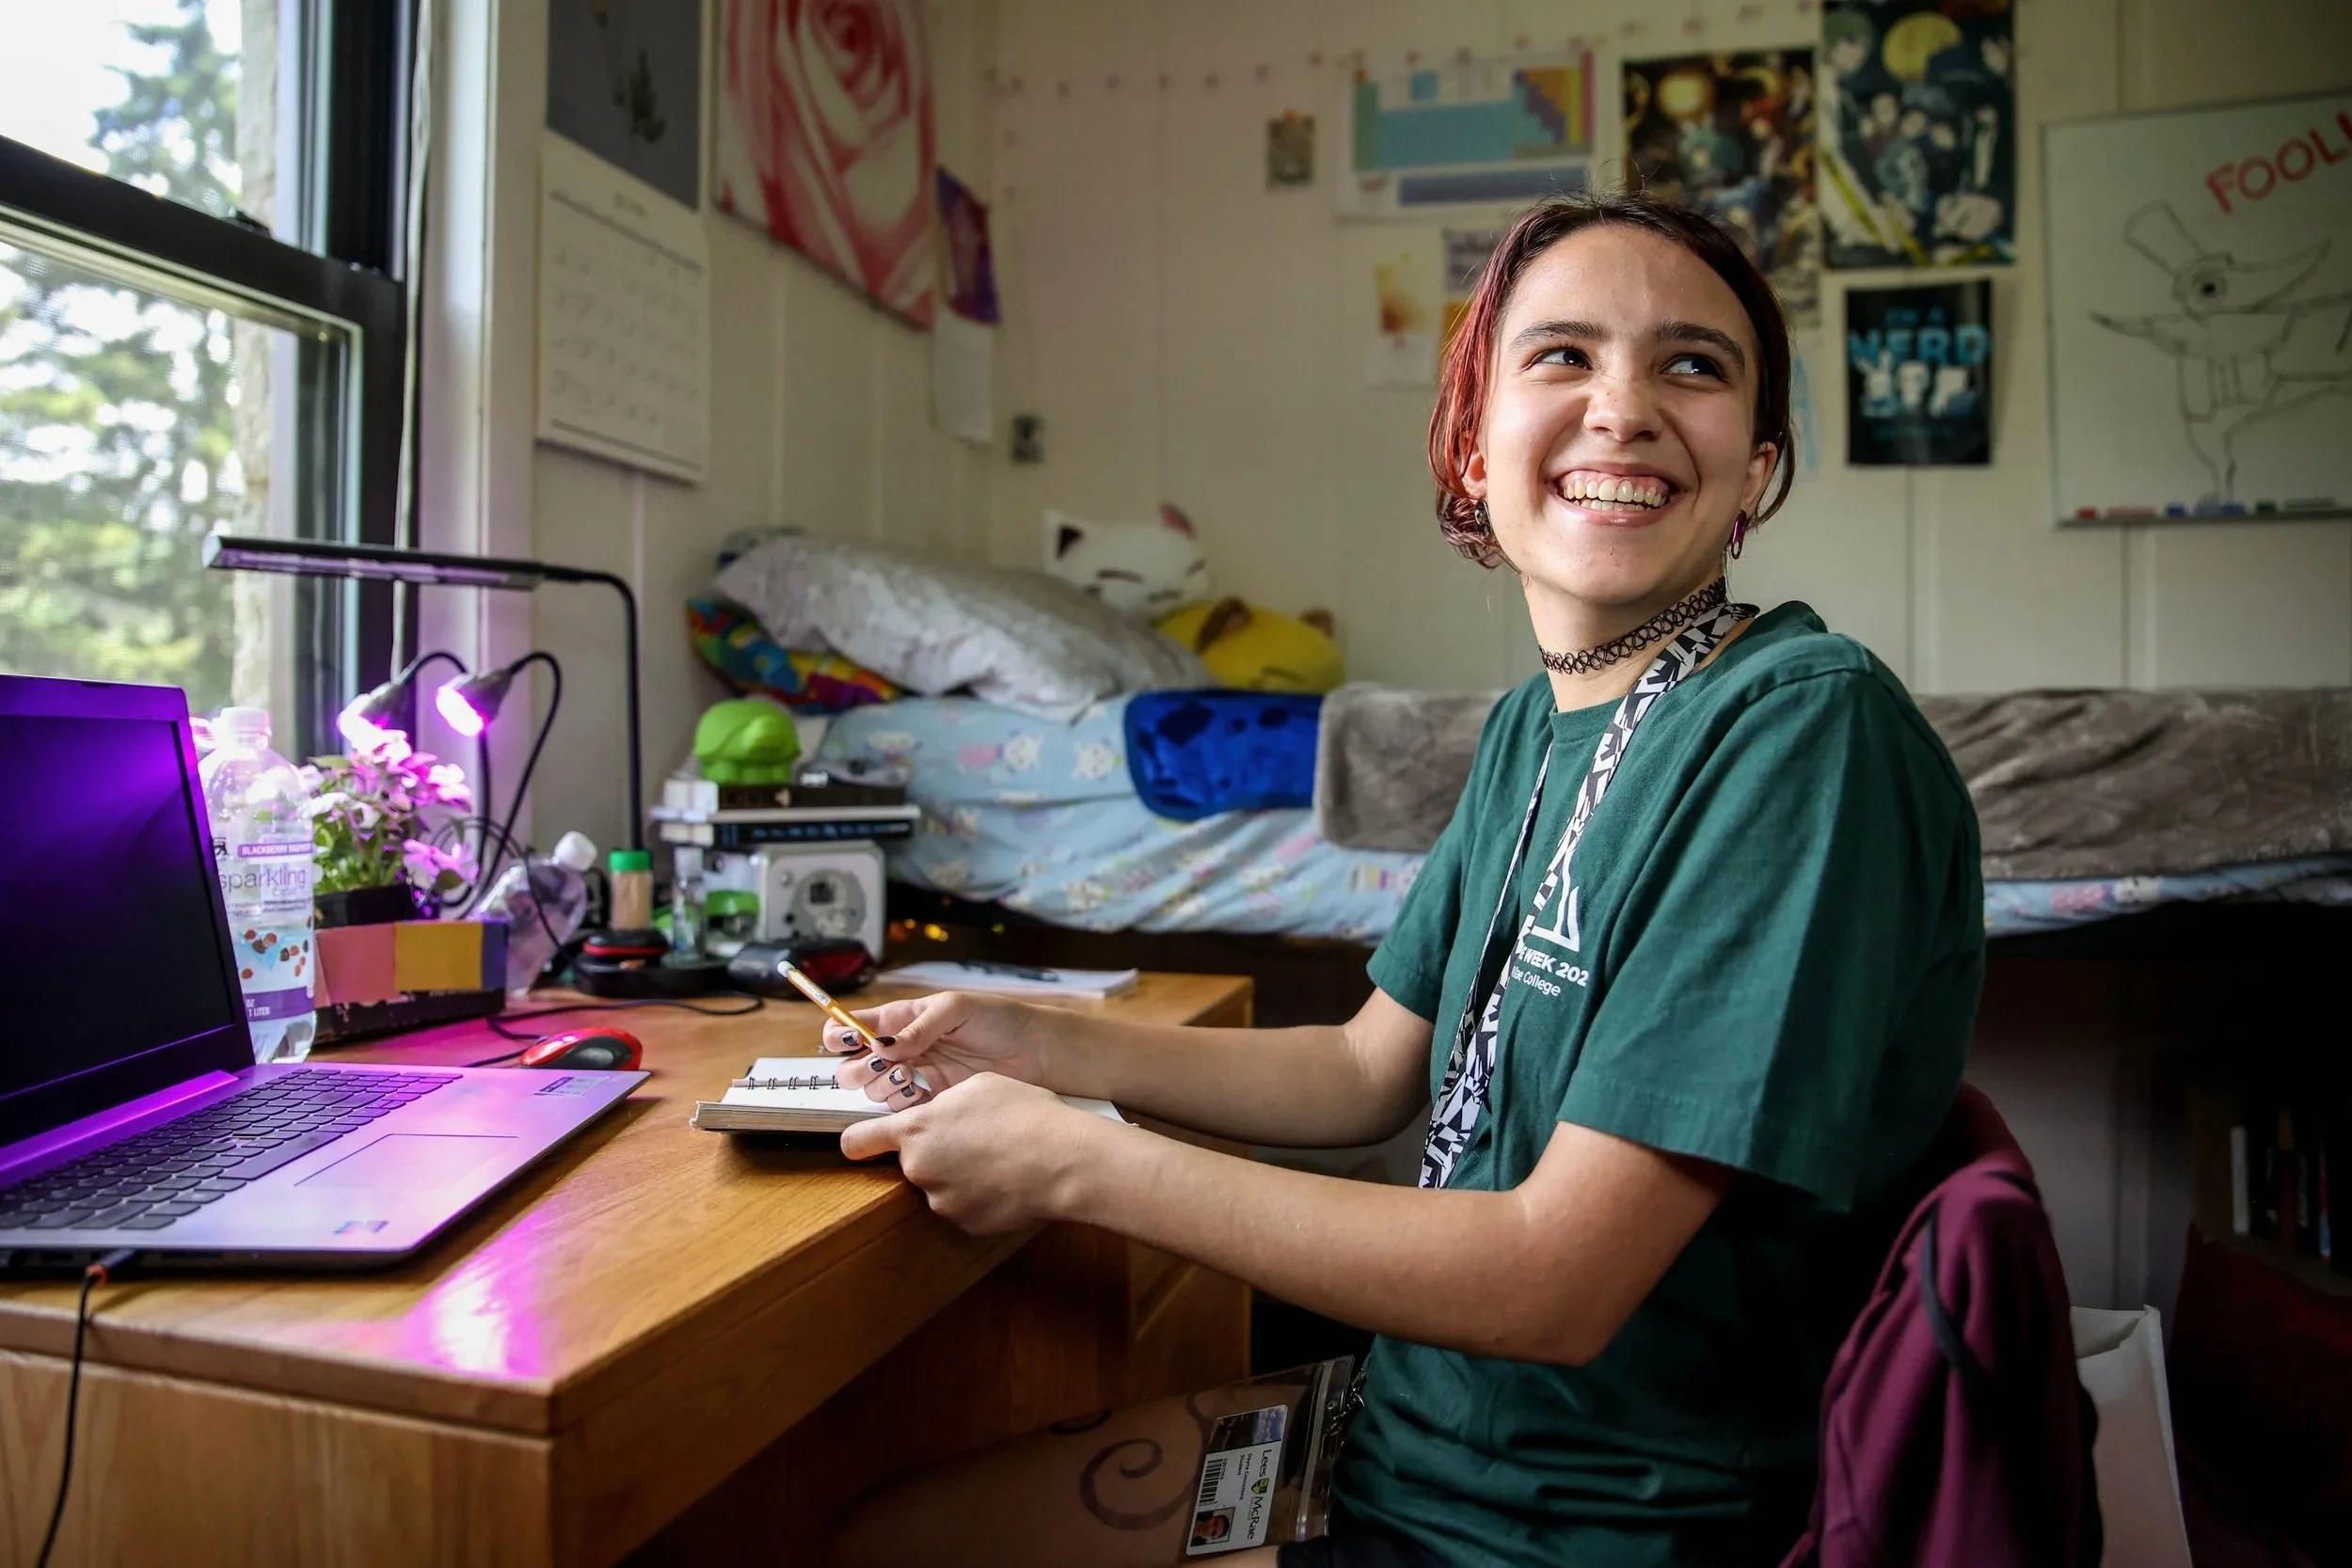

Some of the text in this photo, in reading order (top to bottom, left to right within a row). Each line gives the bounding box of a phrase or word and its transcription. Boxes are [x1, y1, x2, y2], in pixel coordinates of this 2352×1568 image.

[1849, 325, 1989, 368] NERD
[241, 845, 288, 856] BLACKBERRY
[219, 863, 306, 893] sparkling
[1524, 948, 1557, 973] WEEK
[1523, 971, 1561, 996] College
[246, 998, 255, 1008] OZ
[253, 1006, 271, 1017] LITER
[1236, 1455, 1245, 1476] Student
[1248, 1449, 1272, 1540] Lees McRae
